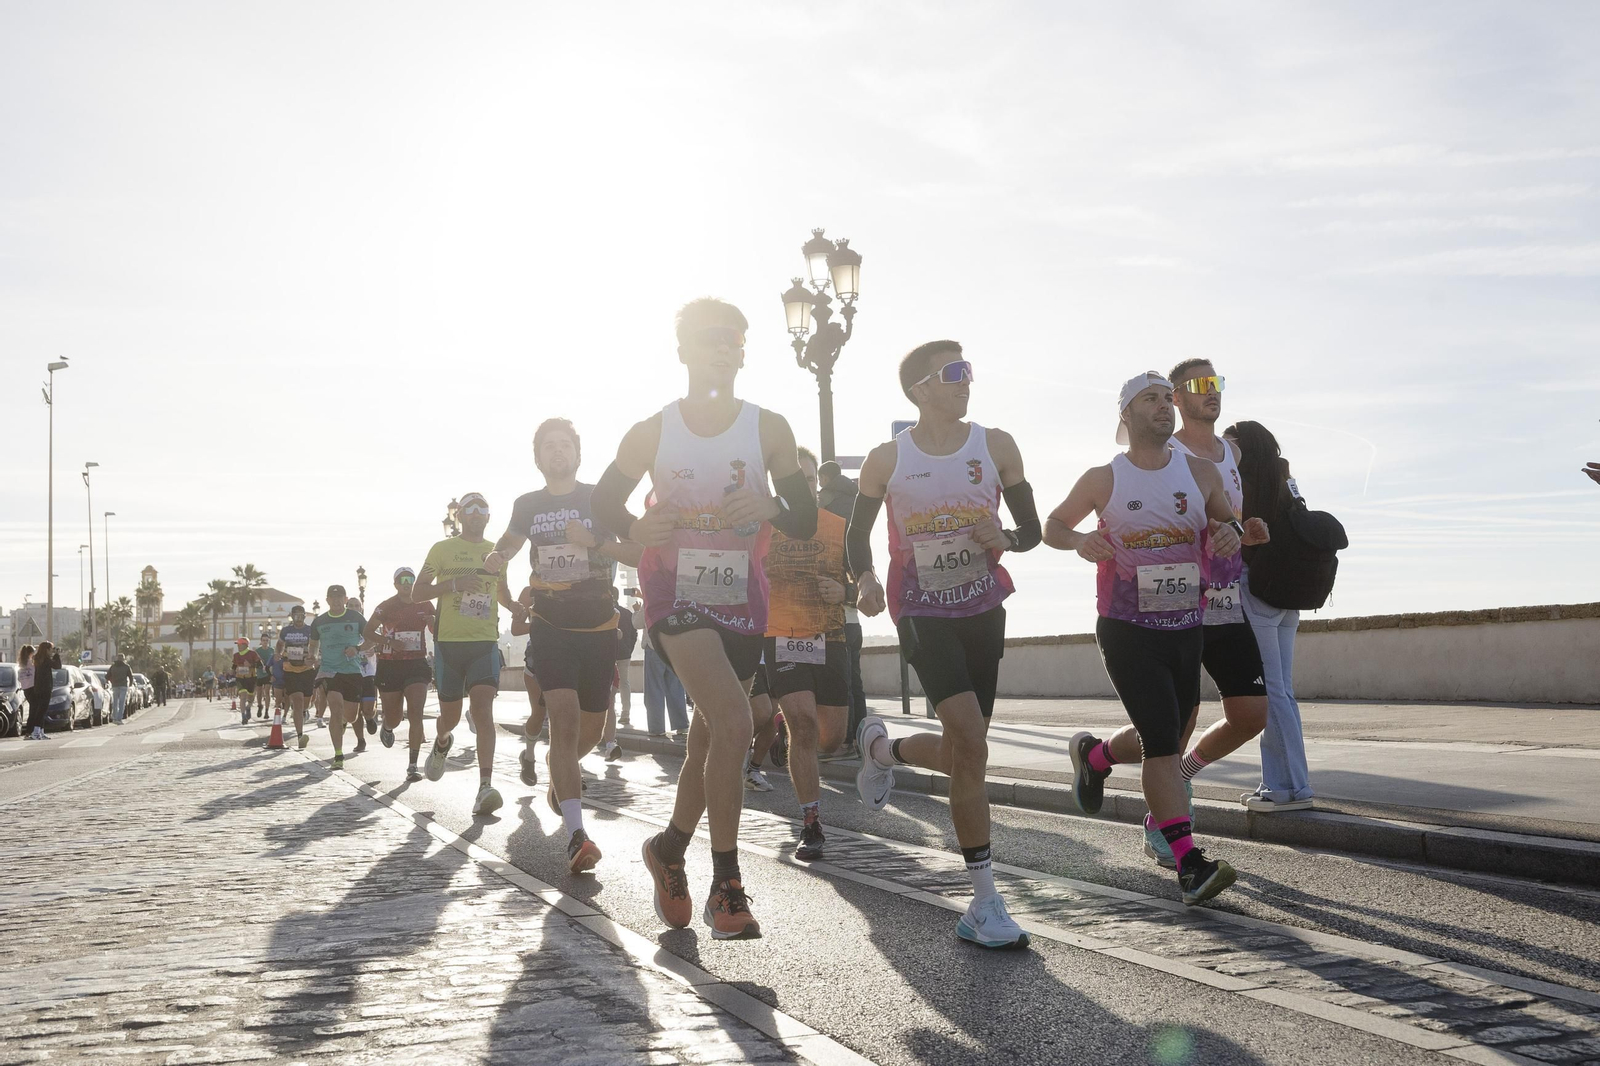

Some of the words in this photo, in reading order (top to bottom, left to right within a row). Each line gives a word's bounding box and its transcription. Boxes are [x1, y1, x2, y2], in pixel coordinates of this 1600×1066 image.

[533, 508, 580, 524] media
[530, 518, 592, 536] maran
[780, 542, 820, 552] GALBIS
[547, 554, 576, 569] 707
[933, 549, 971, 572] 450
[694, 565, 734, 586] 718
[1153, 577, 1187, 595] 755
[786, 640, 814, 653] 668
